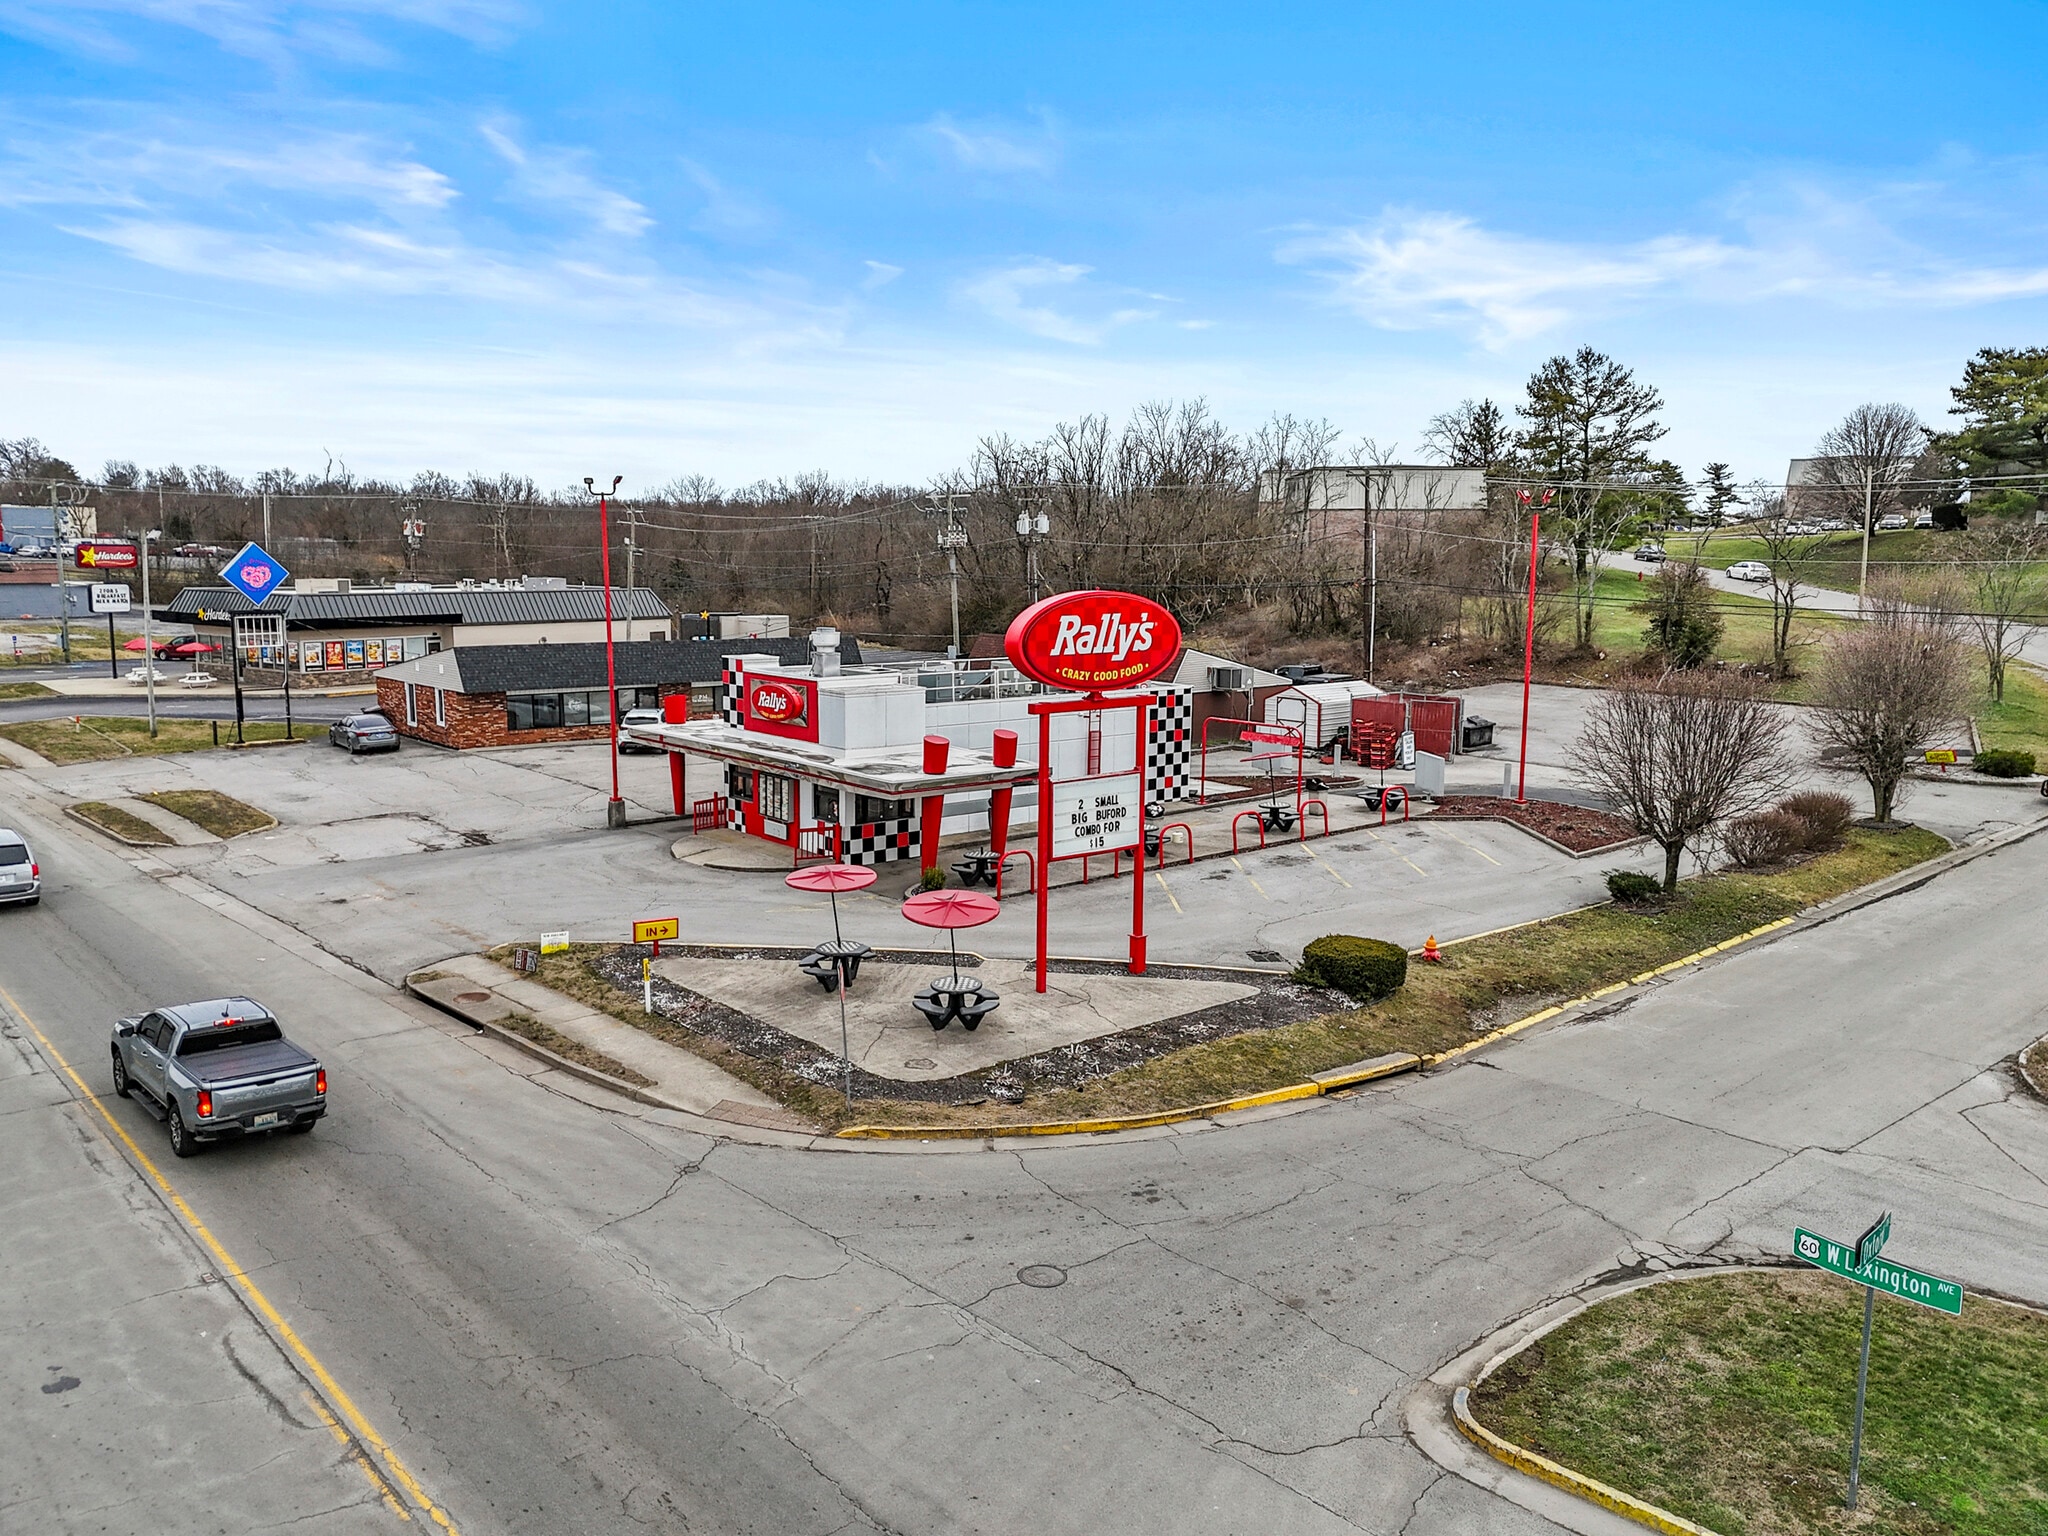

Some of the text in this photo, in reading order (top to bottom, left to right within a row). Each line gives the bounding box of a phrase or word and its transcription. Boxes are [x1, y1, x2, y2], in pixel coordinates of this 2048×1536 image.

[94, 551, 135, 560] Hardee's
[1050, 612, 1155, 662] Rally's
[1062, 663, 1143, 681] CRAZY GOOD FOOD
[758, 691, 787, 712] Rally's
[1078, 794, 1119, 810] 2 SMALL
[1071, 806, 1127, 825] BIG BUFORD
[1075, 820, 1120, 837] COMBO FOR
[1090, 836, 1105, 848] $15
[646, 926, 657, 937] IN
[1801, 1239, 1817, 1255] 60
[1827, 1243, 1841, 1267] W.
[1937, 1282, 1956, 1296] AVE
